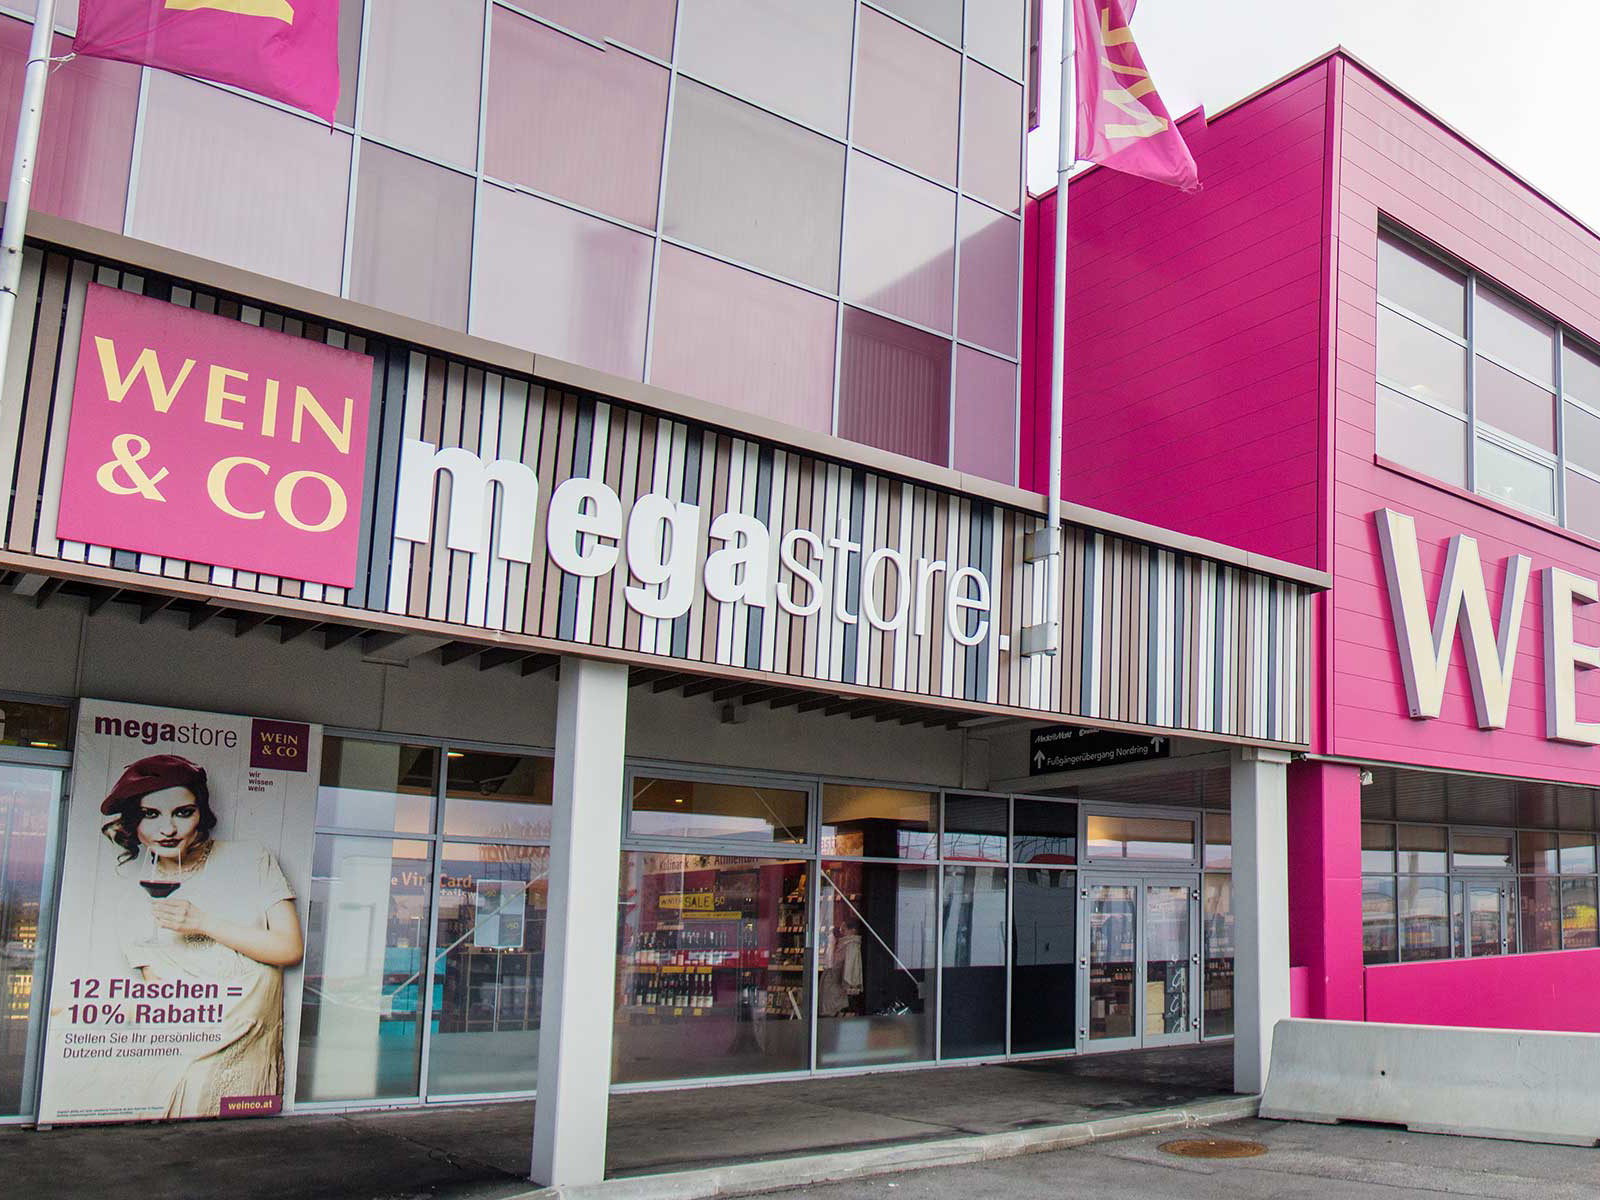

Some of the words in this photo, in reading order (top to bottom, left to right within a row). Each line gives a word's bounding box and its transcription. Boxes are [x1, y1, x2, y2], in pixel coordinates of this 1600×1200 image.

[95, 336, 354, 455] WEIN
[96, 433, 170, 503] &
[207, 456, 348, 533] CO
[95, 716, 238, 748] megastore
[260, 731, 298, 746] WEIN
[261, 745, 273, 756] &
[276, 746, 298, 758] CO
[1116, 745, 1149, 757] Nordring
[248, 778, 274, 787] wissen
[685, 895, 711, 908] SALE
[70, 978, 100, 999] 12
[109, 979, 219, 999] Flaschen
[227, 986, 243, 997] =
[68, 1004, 125, 1025] 10%
[135, 1004, 224, 1025] Rabatt!
[65, 1032, 106, 1044] Stellen
[109, 1032, 128, 1043] Sie
[132, 1032, 147, 1043] Ihr
[150, 1031, 222, 1045] persönliches
[63, 1047, 113, 1059] Dutzend
[116, 1047, 182, 1058] zusammen.
[228, 1100, 273, 1111] weinco.at
